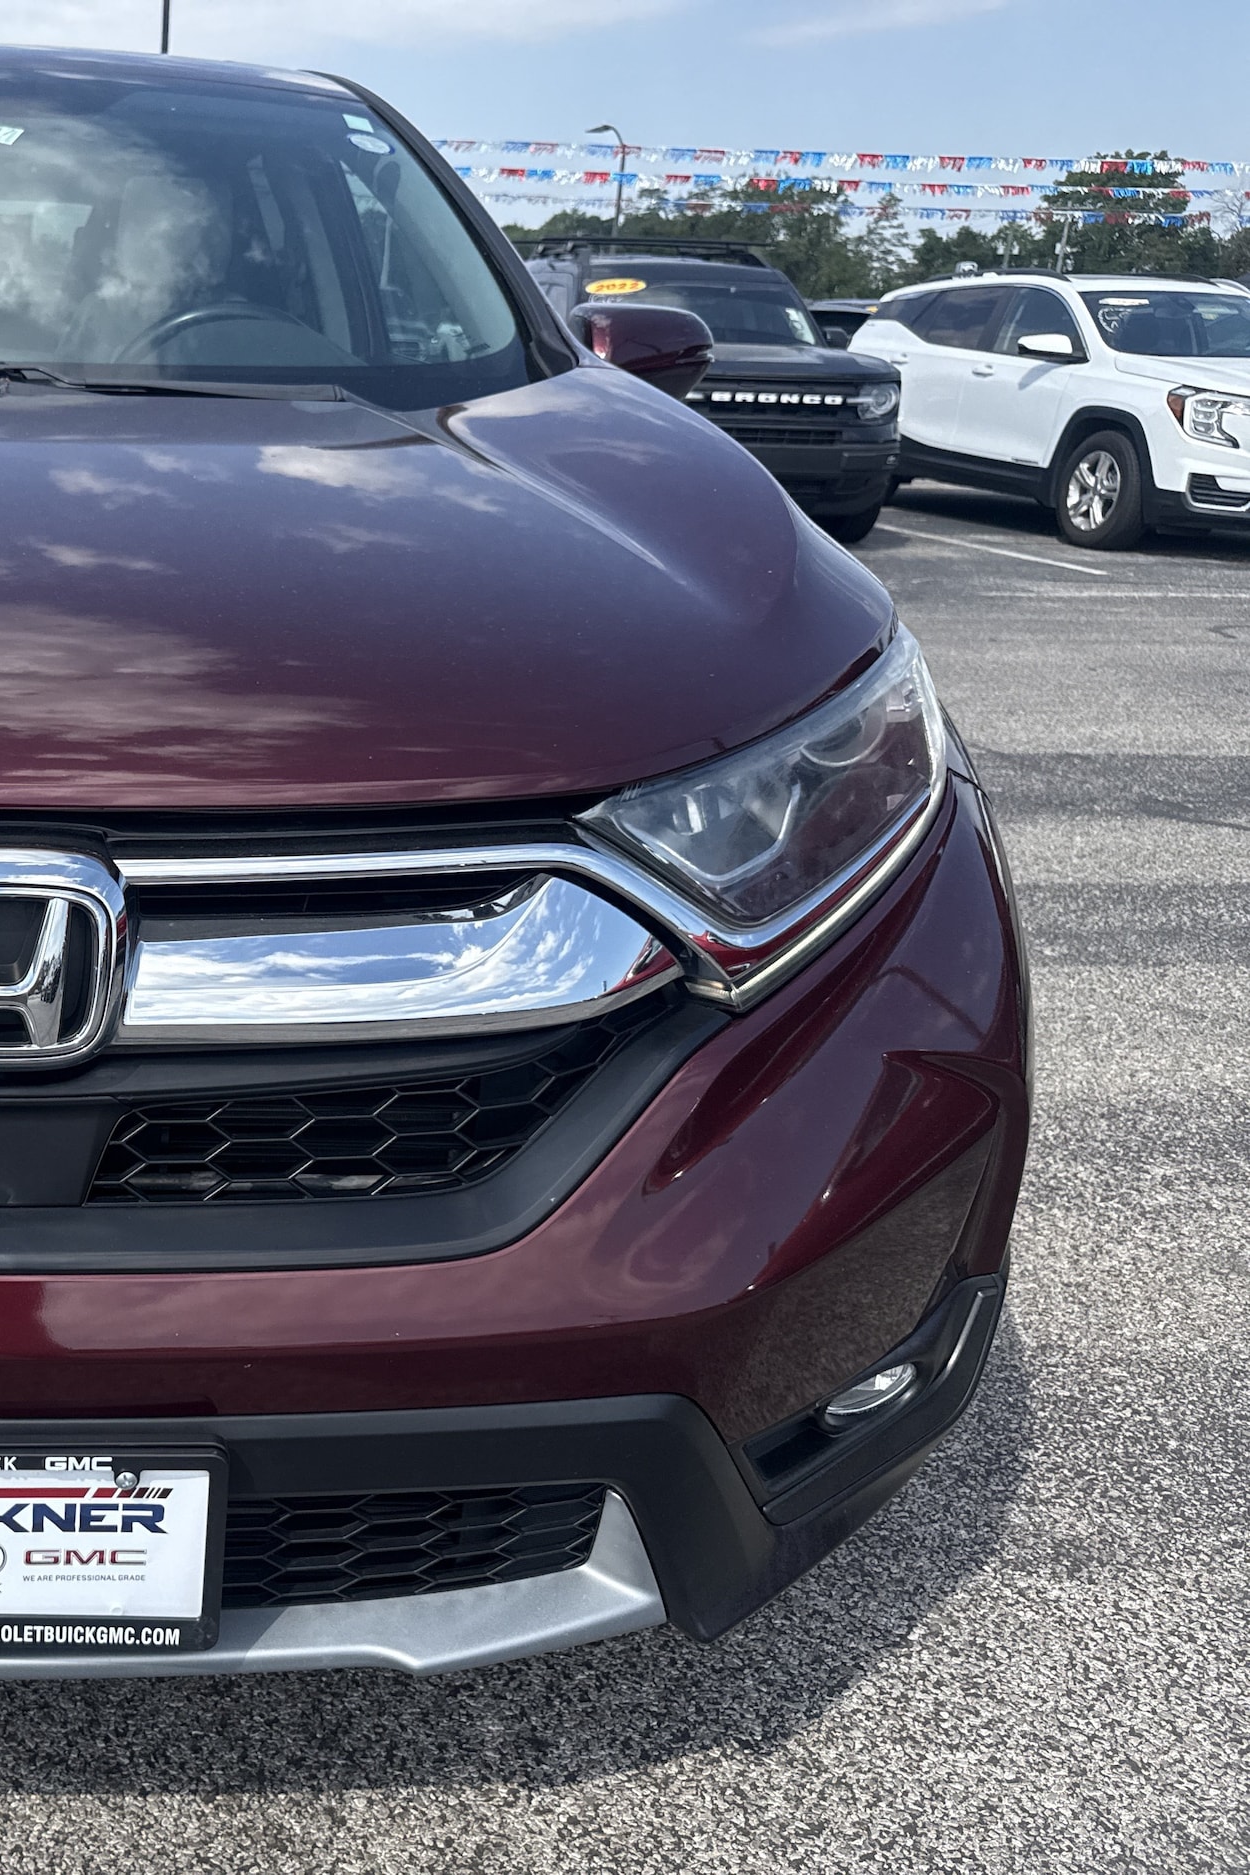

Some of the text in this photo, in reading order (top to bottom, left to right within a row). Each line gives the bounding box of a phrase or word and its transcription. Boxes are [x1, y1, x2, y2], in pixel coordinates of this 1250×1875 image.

[595, 281, 639, 293] 2022
[710, 391, 844, 406] BRONCO
[44, 1456, 114, 1472] GMC
[23, 1548, 148, 1566] GMC
[22, 1574, 147, 1582] WE ARE PROFESSIONAL GRADE
